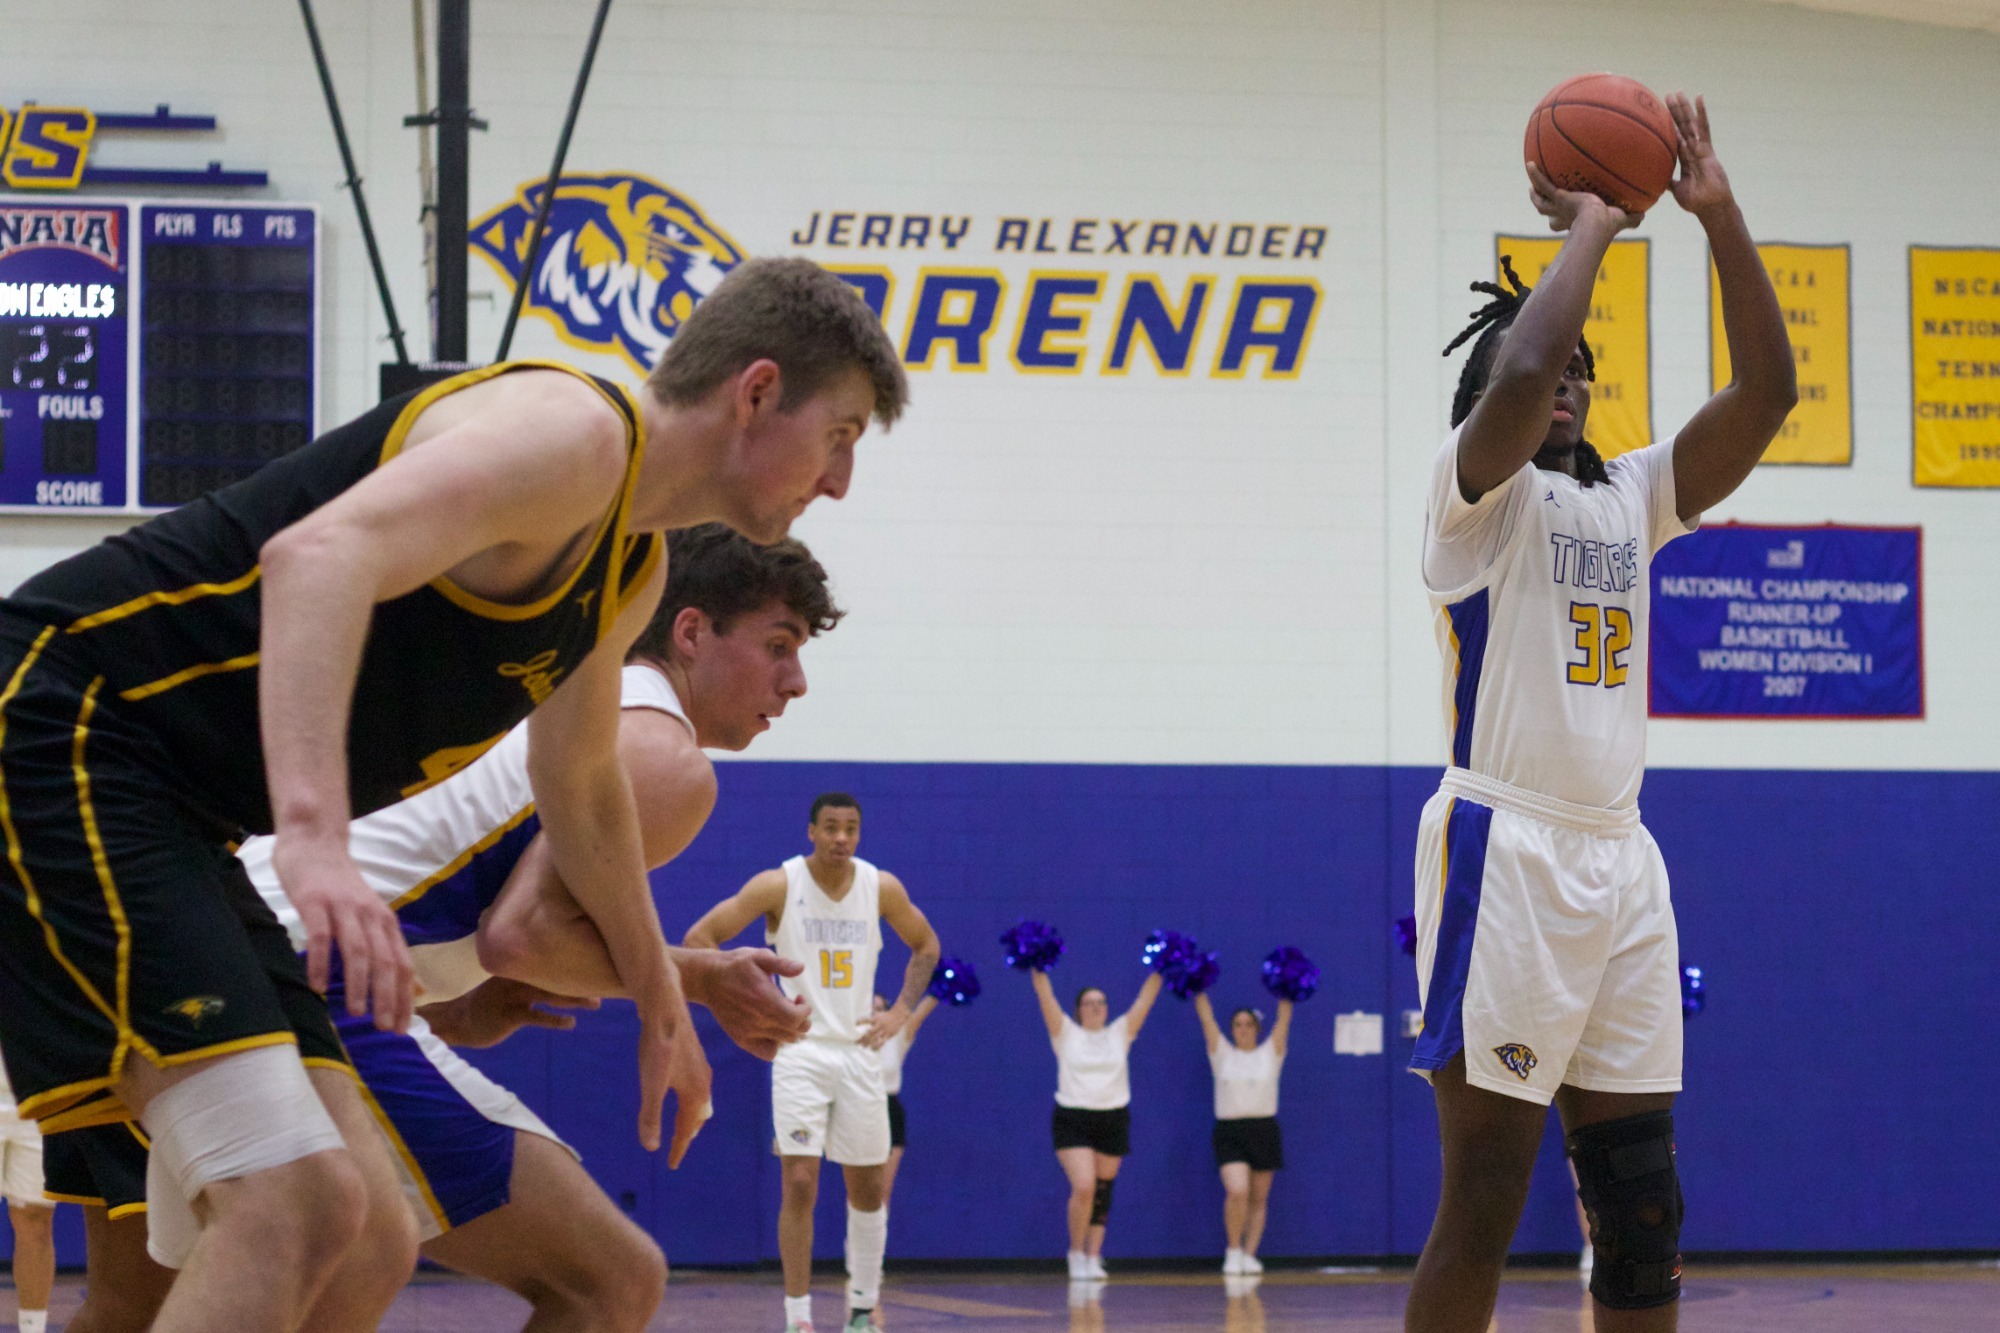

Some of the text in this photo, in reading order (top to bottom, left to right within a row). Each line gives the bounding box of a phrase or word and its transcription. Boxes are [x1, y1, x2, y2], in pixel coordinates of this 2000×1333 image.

[155, 213, 196, 237] PLYR
[213, 214, 243, 238] FLS
[265, 215, 296, 239] PTS
[791, 211, 1329, 260] JERRY ALEXANDER
[0, 213, 116, 263] NAIA
[30, 283, 115, 318] EAGLES
[13, 325, 94, 390] 22
[38, 395, 104, 420] FOULS
[1918, 402, 2000, 420] CHAMP
[36, 480, 104, 505] SCORE
[1660, 576, 1909, 604] NATIONAL CHAMPIONSHIP
[1728, 602, 1842, 625] RUNNER-UP
[1566, 600, 1633, 689] 32
[1721, 626, 1850, 650] BASKETBALL
[1698, 649, 1873, 675] WOMEN DIVISION I
[1763, 675, 1808, 698] 2007
[803, 918, 868, 944] TIGERS
[819, 949, 853, 988] 15
